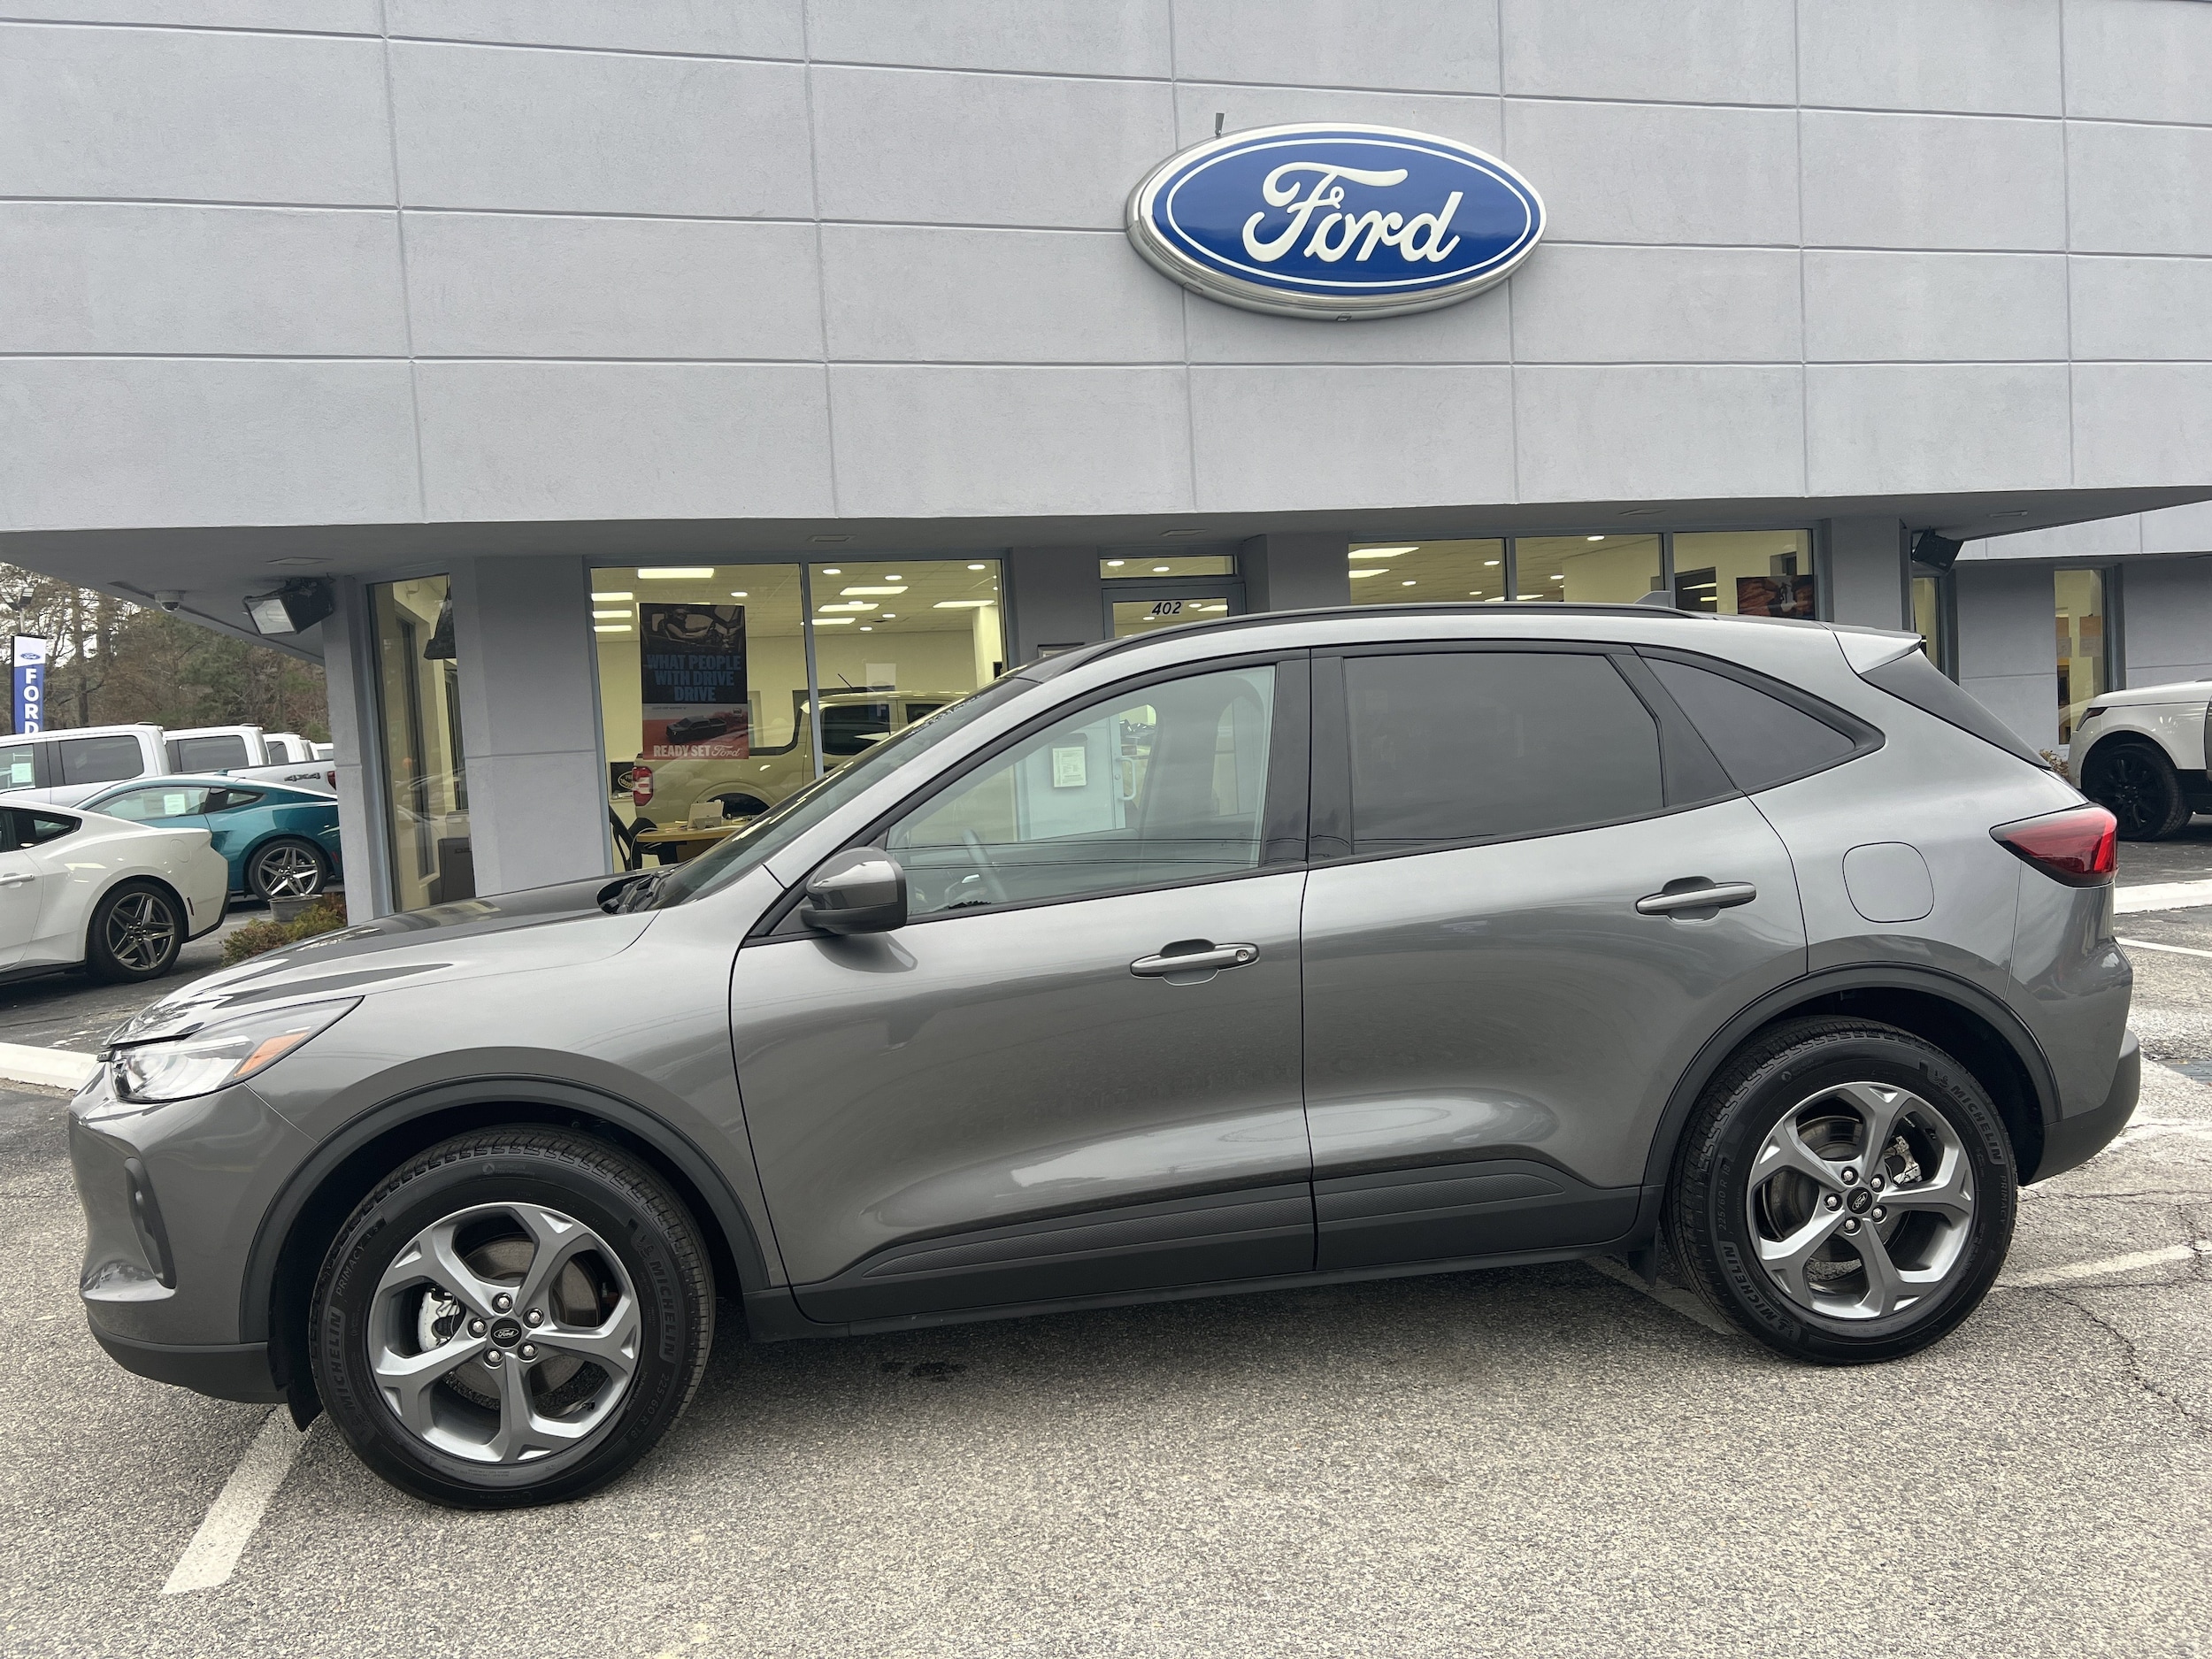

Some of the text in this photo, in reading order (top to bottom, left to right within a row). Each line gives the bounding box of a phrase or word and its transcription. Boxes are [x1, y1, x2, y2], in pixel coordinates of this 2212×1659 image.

[1241, 162, 1465, 263] Ford
[1151, 602, 1182, 615] 402
[647, 655, 741, 670] WHAT PEOPLE
[656, 671, 734, 686] WITH DRIVE
[674, 686, 716, 701] DRIVE
[653, 745, 742, 757] READY SET Ford
[1951, 1086, 2002, 1160] MICHELIN
[1717, 1190, 1726, 1231] 225/60
[336, 1242, 365, 1296] PRIMACY
[1724, 1246, 1778, 1320] MICHELIN
[649, 1260, 677, 1356] MICHELIN
[328, 1311, 354, 1409] MICHELIN
[648, 1373, 670, 1414] 225/60
